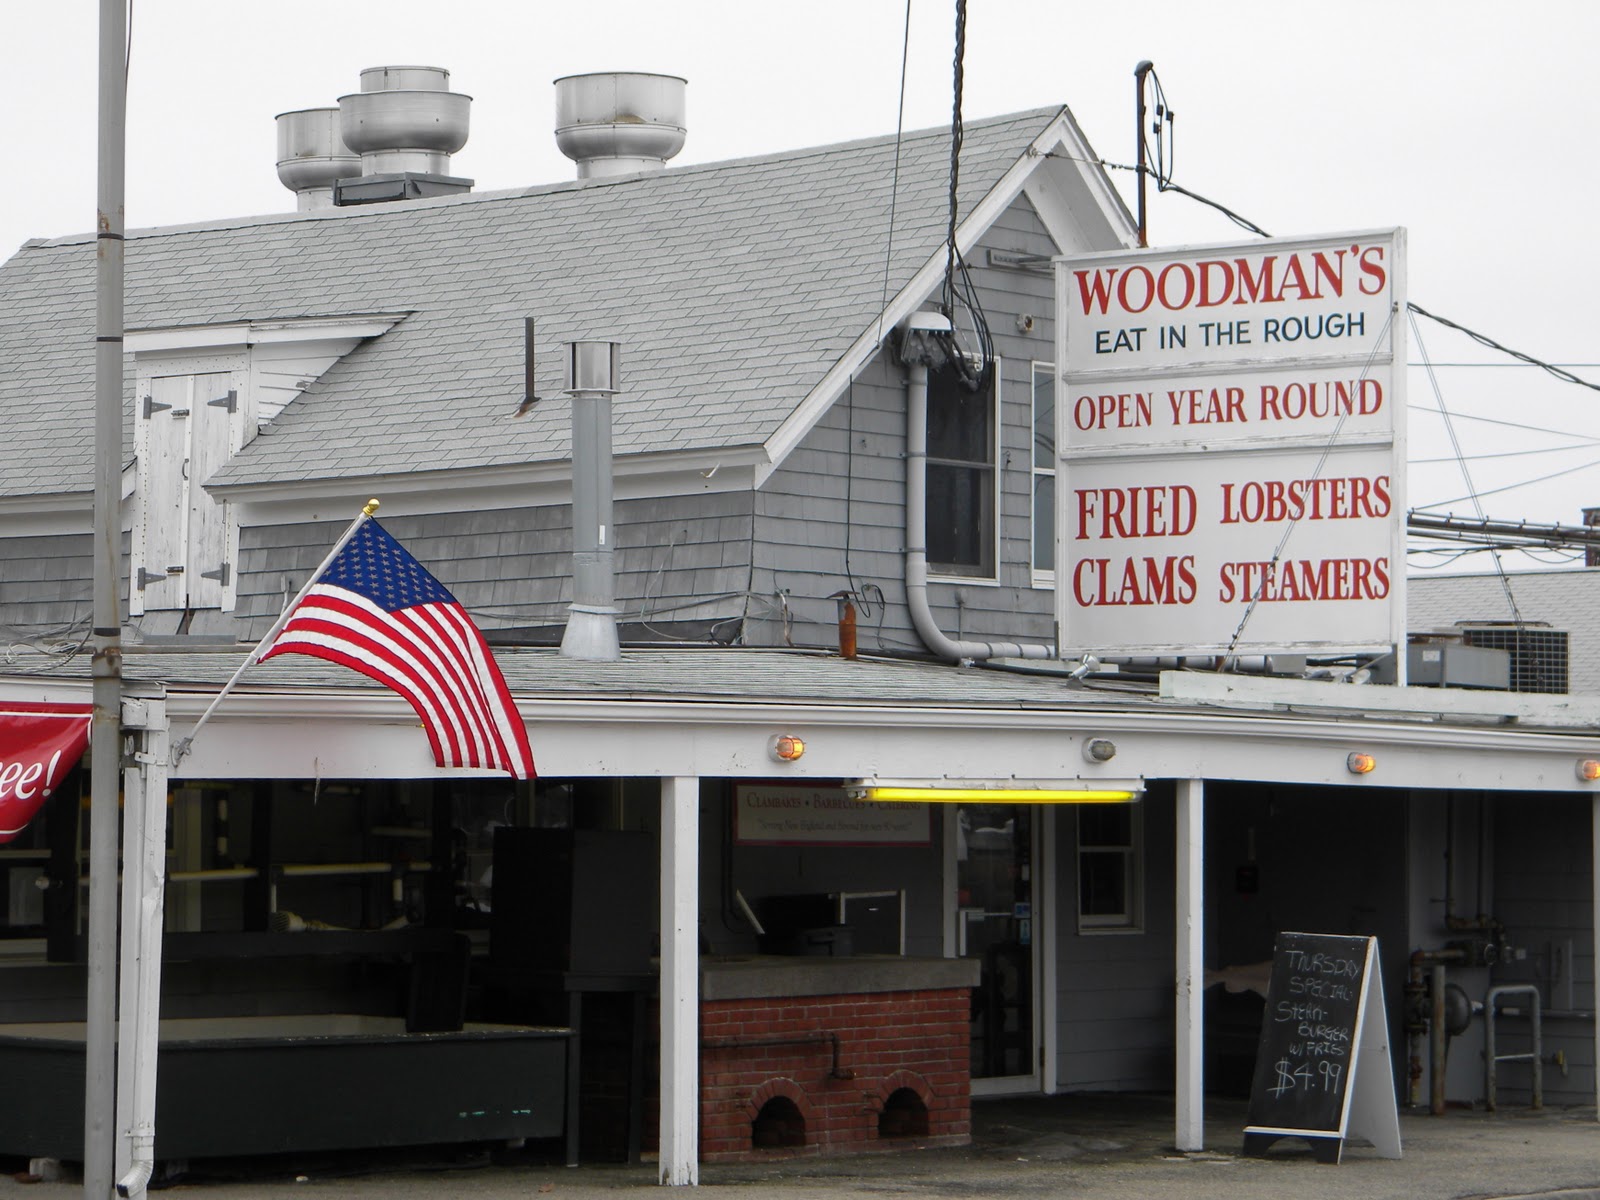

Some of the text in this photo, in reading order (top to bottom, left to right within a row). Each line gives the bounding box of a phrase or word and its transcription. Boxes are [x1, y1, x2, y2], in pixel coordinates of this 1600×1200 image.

[1073, 244, 1386, 316] WOODMAN'S
[1095, 312, 1365, 354] EAT IN THE ROUGH
[1074, 379, 1383, 431] OPEN YEAR ROUND
[1074, 485, 1197, 540] FRIED
[1219, 475, 1391, 524] LOBSTERS
[1073, 555, 1198, 607] CLAMS
[1219, 557, 1390, 603] STEAMERS
[0, 749, 62, 800] ee!
[1285, 950, 1360, 979] THURSDAY
[1298, 1021, 1348, 1041] BURGER
[1266, 1056, 1342, 1099] $4.99
